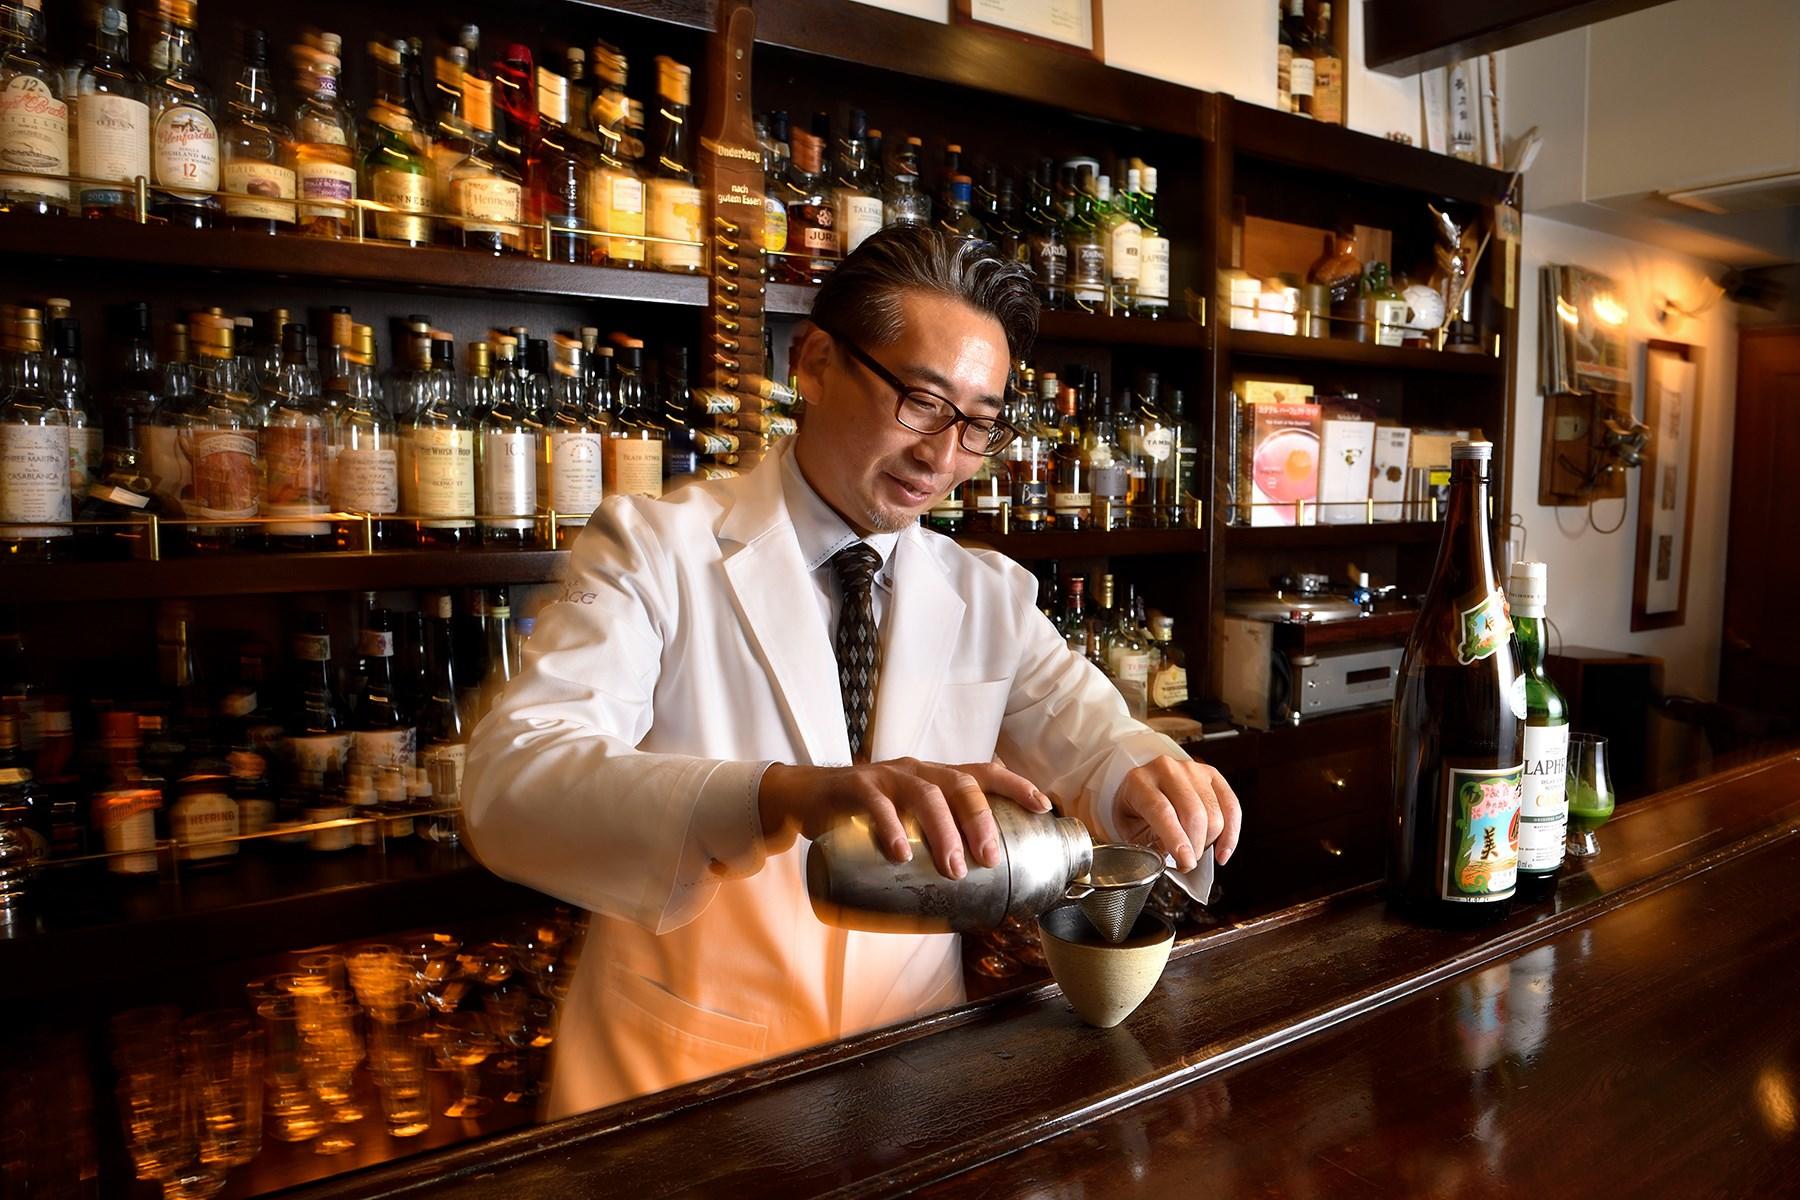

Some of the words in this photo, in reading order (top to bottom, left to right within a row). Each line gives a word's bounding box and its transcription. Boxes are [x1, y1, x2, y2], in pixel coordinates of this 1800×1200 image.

[22, 79, 38, 91] 12
[718, 146, 761, 164] Underberg
[183, 163, 198, 177] 12
[731, 185, 749, 194] nach
[718, 195, 741, 204] gutem
[742, 195, 761, 205] Essen
[1480, 826, 1499, 860] 美
